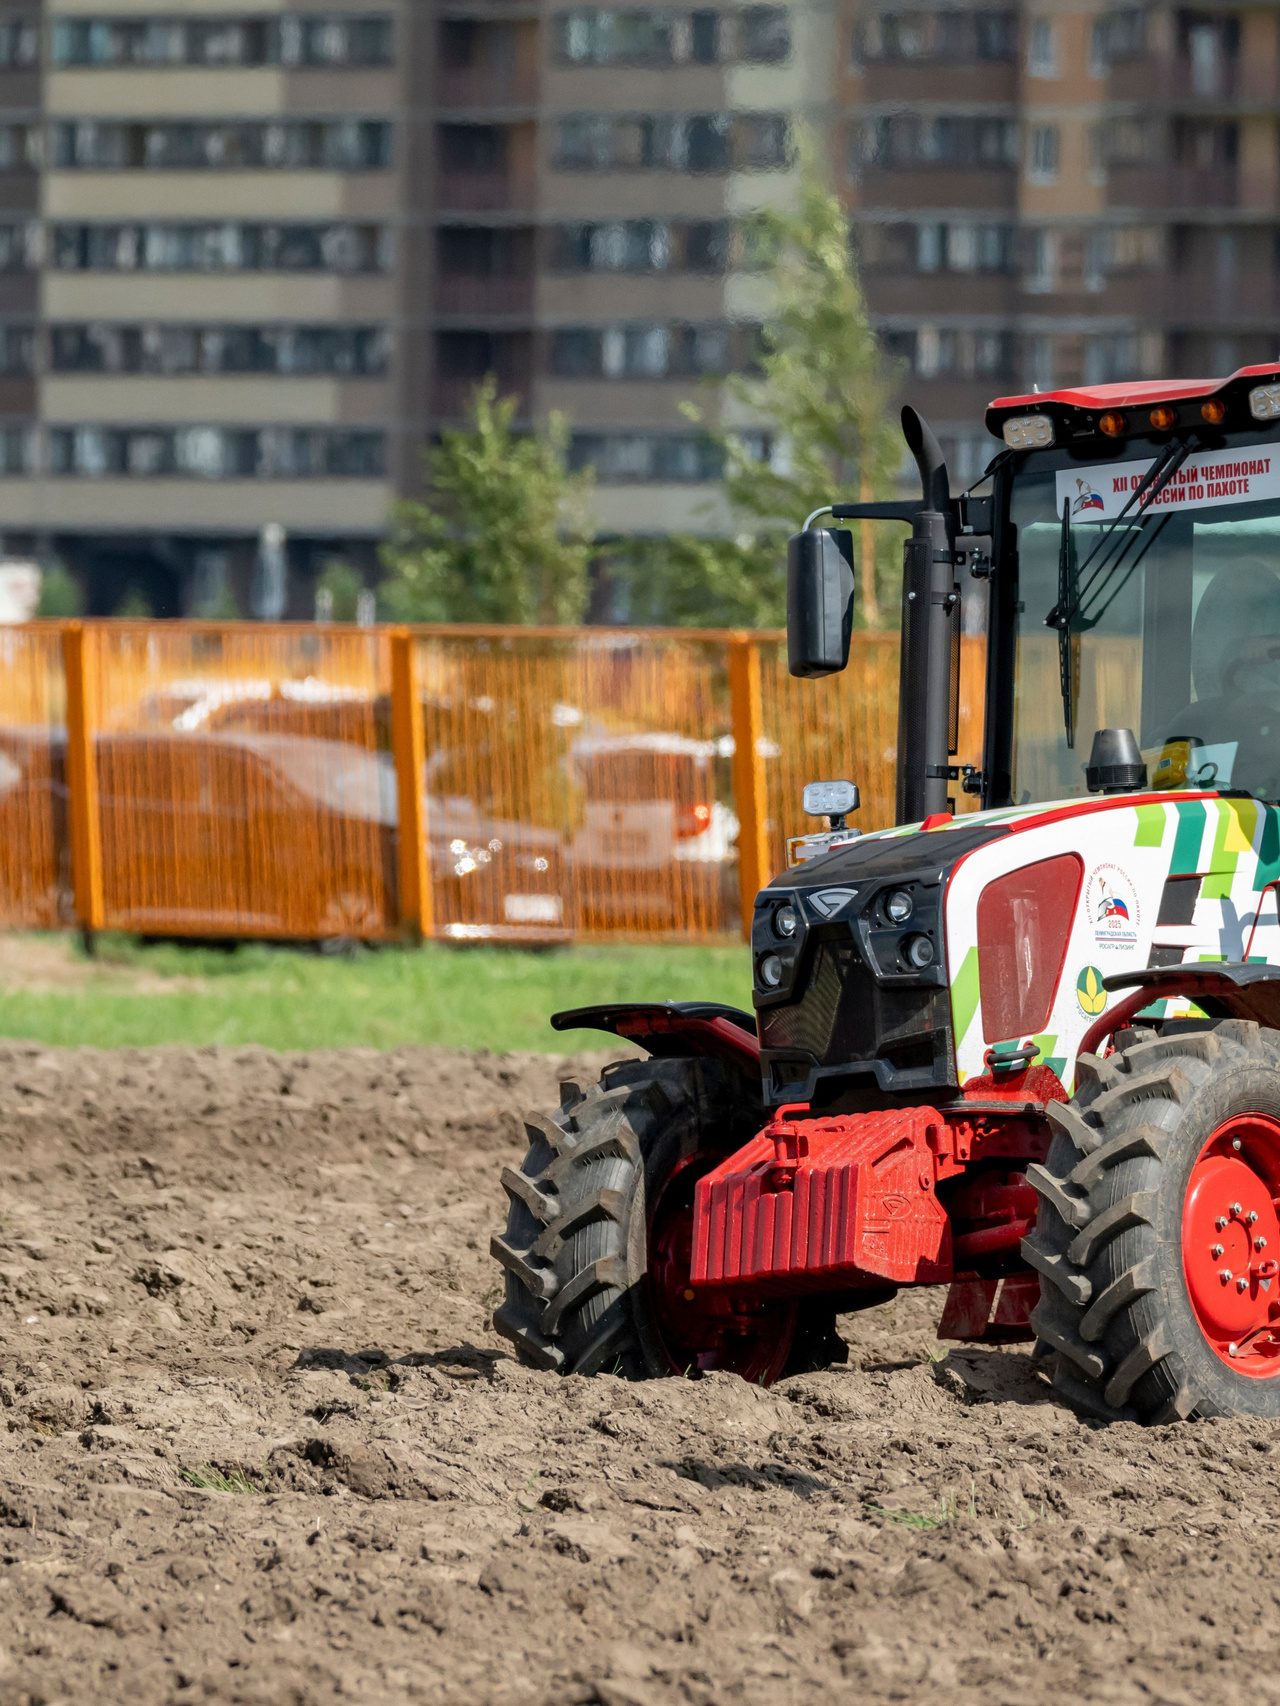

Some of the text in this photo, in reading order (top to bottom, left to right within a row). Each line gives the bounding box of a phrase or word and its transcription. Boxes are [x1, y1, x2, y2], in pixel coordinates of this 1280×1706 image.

[1130, 464, 1198, 491] ОТТЫЙ
[1201, 458, 1271, 481] ЧЕМПИОНАТ
[1189, 484, 1204, 501] ПО
[1207, 478, 1250, 498] ПАХОТЕ
[1108, 919, 1122, 929] 2025
